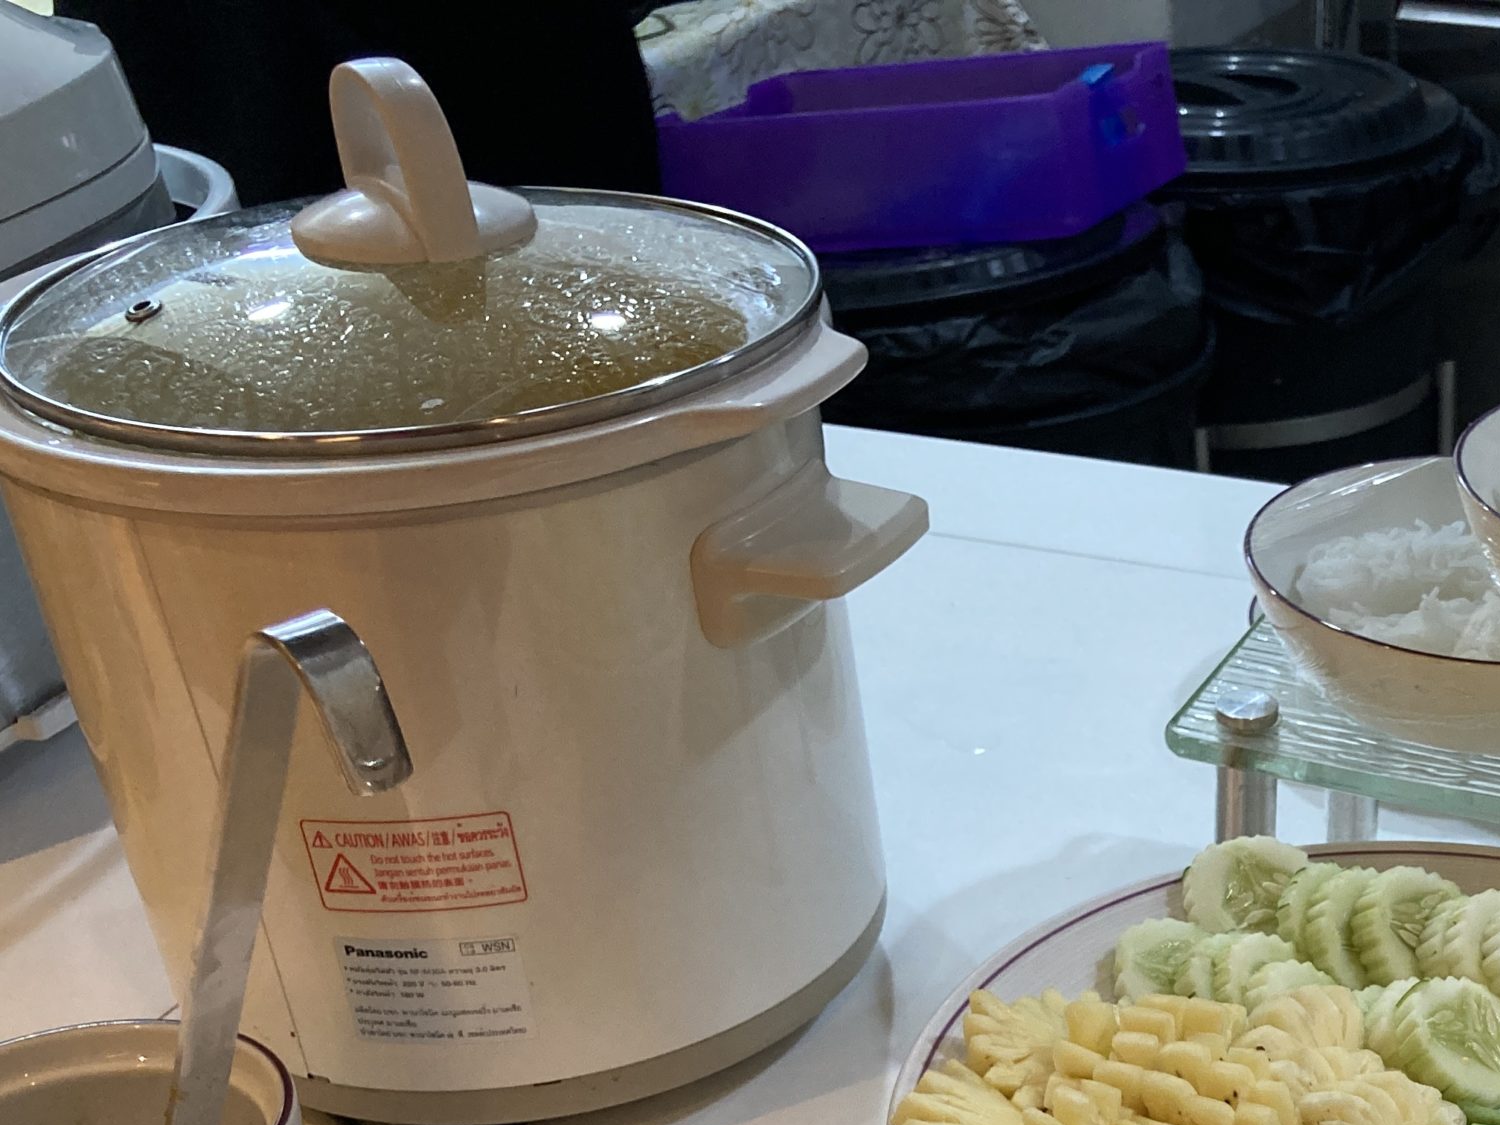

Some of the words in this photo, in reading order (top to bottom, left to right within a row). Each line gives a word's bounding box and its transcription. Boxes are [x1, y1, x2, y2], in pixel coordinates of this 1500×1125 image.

[335, 832, 385, 848] CAUTION
[392, 830, 425, 848] AWAS
[370, 854, 384, 865] Do
[385, 855, 399, 864] not
[427, 852, 441, 862] the
[442, 851, 458, 861] hot
[344, 945, 428, 959] Panasonic
[481, 941, 511, 952] WSN
